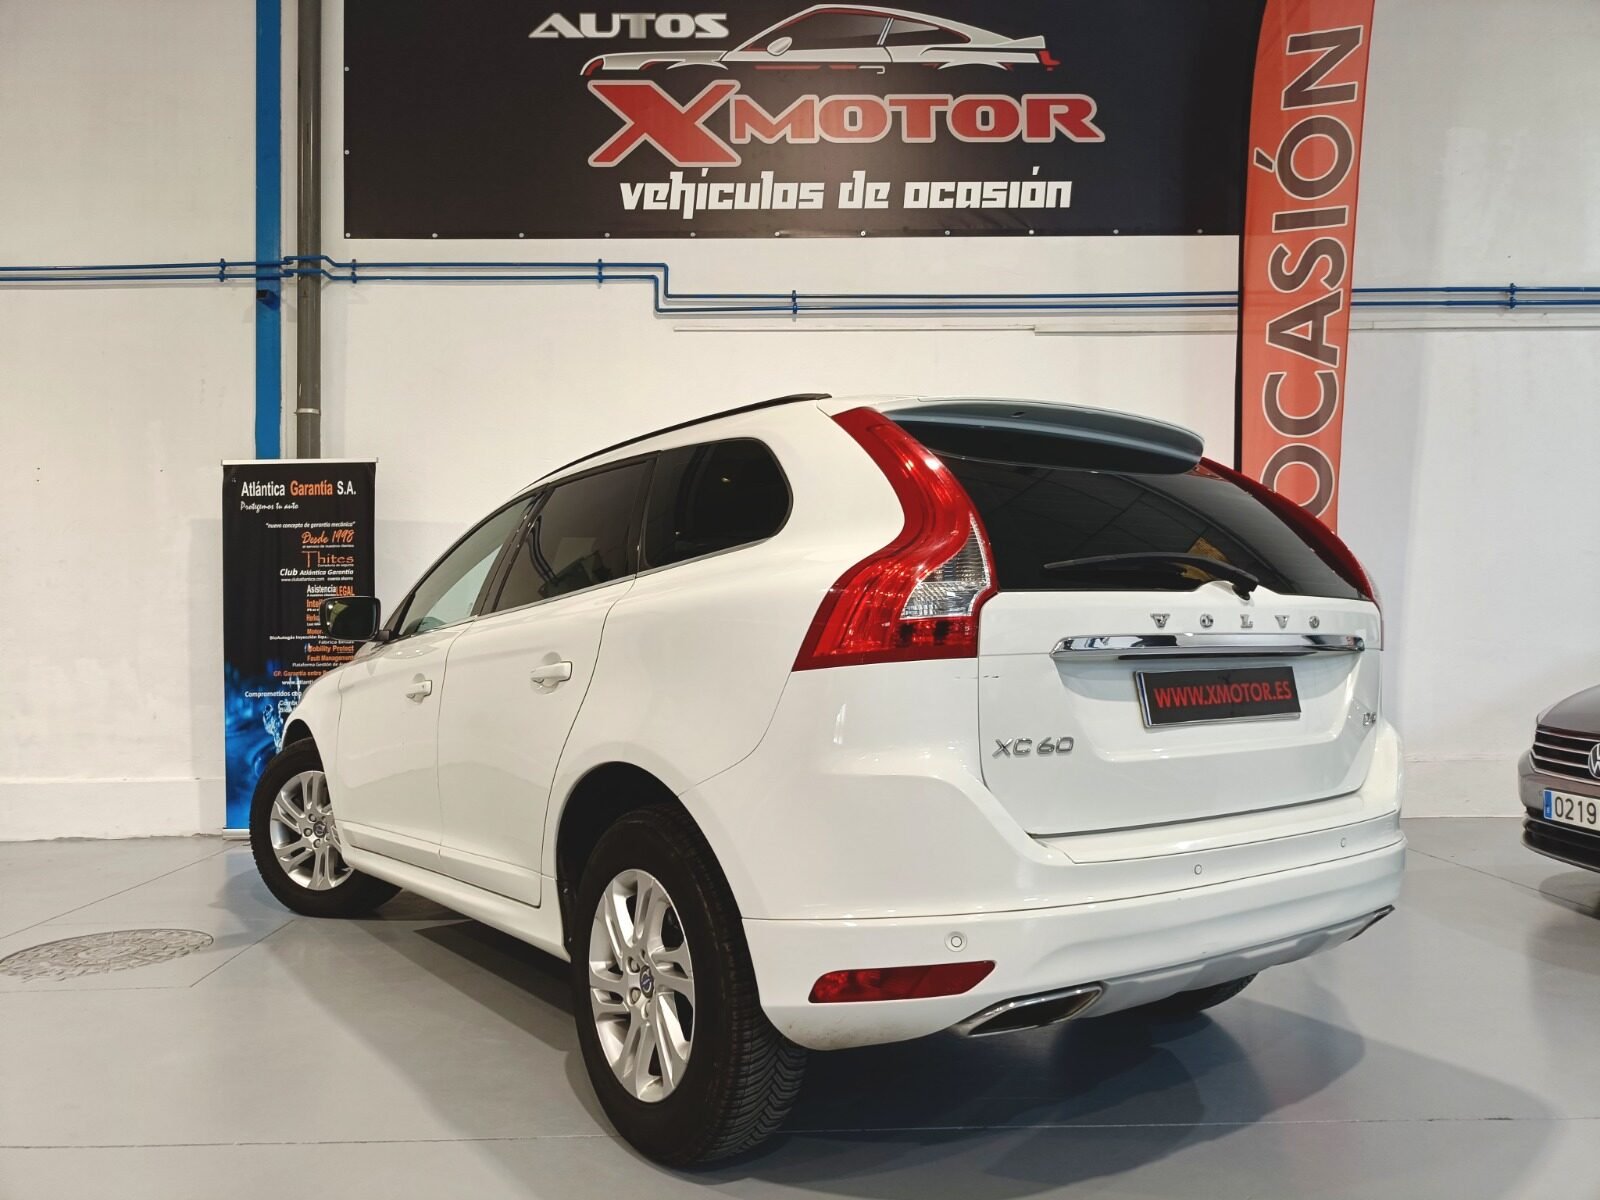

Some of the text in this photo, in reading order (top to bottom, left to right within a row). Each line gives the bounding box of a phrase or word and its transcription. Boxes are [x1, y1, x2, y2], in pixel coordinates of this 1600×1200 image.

[528, 13, 730, 39] AUTOS
[587, 79, 1106, 168] XMOTOR
[619, 166, 1072, 220] vehículos de ocasión
[1254, 25, 1364, 519] OCASIÓN
[240, 479, 357, 497] Atlántica Garantía S.A.
[301, 529, 355, 544] Desde 1998
[279, 568, 299, 576] Club
[1150, 613, 1321, 629] VOLVO
[244, 691, 291, 699] Comprometidos
[1153, 681, 1293, 708] WWW.XMOTOR.ES
[1554, 796, 1598, 825] 0219
